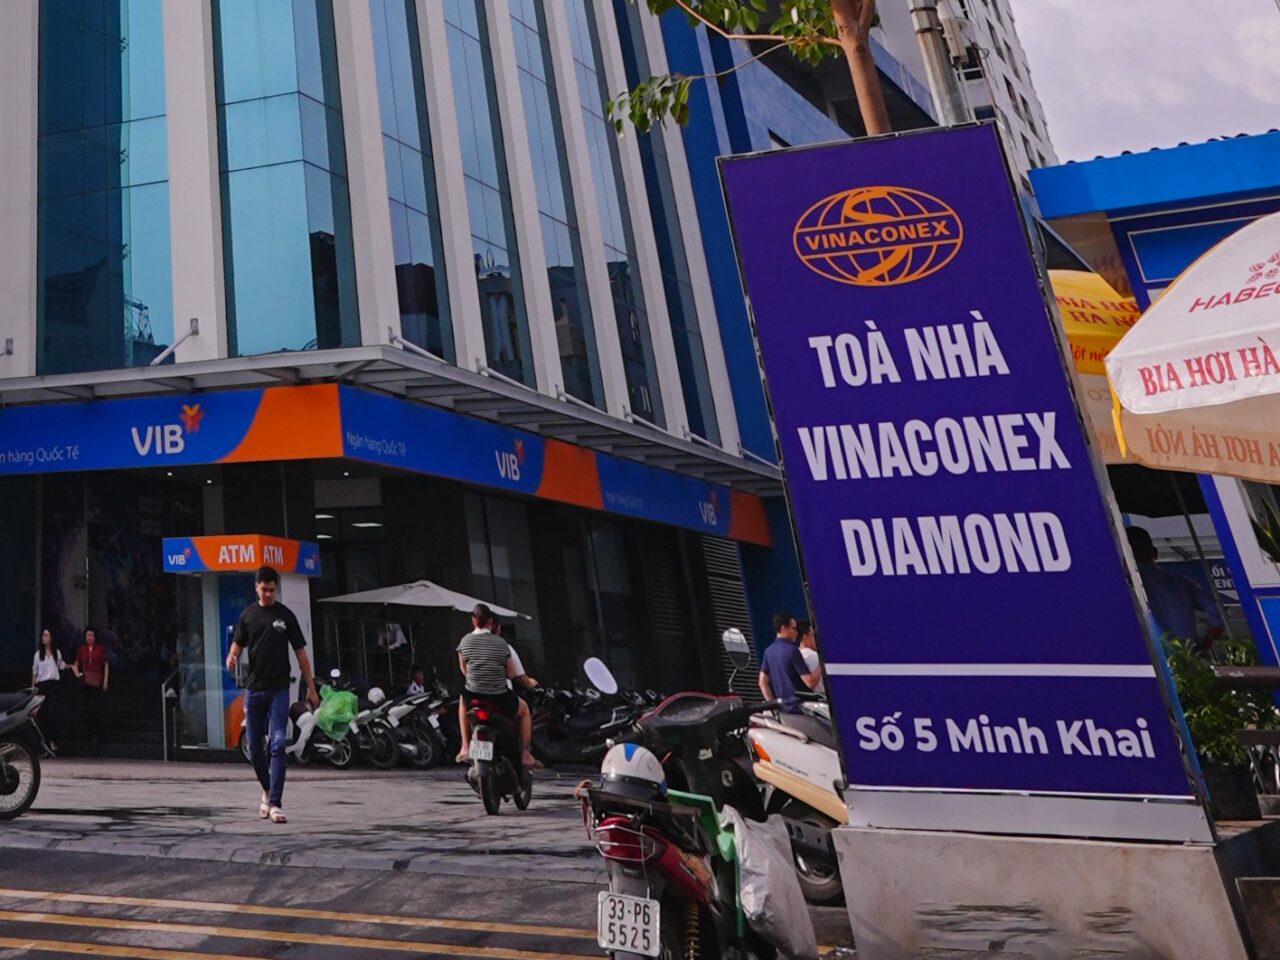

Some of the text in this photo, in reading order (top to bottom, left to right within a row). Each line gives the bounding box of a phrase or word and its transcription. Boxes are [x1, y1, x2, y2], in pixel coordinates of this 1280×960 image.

[804, 220, 951, 251] VINACONEX
[808, 310, 1011, 388] TOÀ NHÀ
[1138, 336, 1280, 397] BIA HƠI HÀ
[8, 448, 34, 466] hàng
[36, 446, 64, 463] Quốc
[66, 444, 80, 460] Tế
[131, 424, 185, 456] VIB
[797, 411, 1073, 481] VINACONEX
[495, 449, 521, 481] VIB
[699, 500, 718, 526] VIB
[218, 544, 255, 564] ATM
[263, 545, 284, 564] ATM
[840, 511, 1072, 577] DIAMOND
[168, 554, 186, 565] VIB
[304, 558, 315, 569] VIB
[855, 711, 1156, 758] Số 5 Minh Khai
[608, 898, 651, 926] 33-P6
[608, 922, 651, 951] 5525
